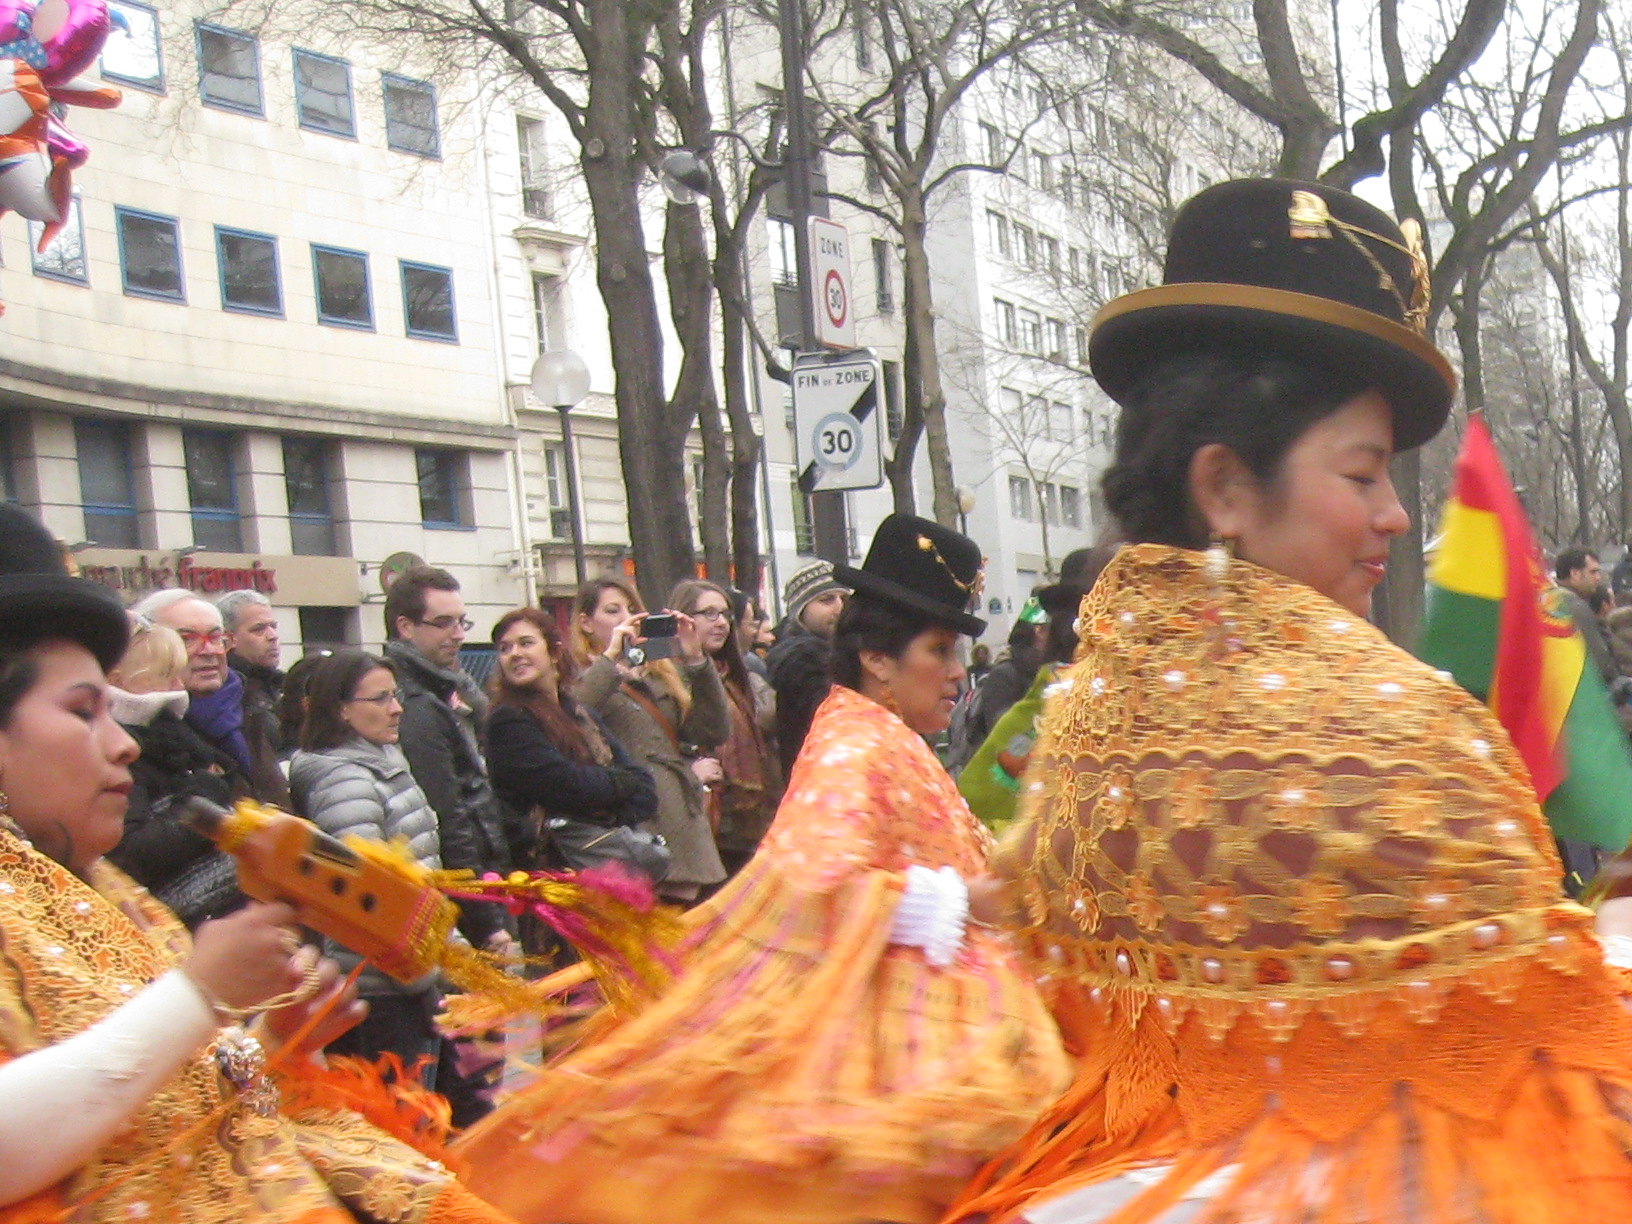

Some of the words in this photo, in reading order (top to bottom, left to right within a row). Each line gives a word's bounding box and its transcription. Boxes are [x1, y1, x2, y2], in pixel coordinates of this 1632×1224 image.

[820, 237, 844, 258] ZONE
[830, 288, 841, 309] 30
[798, 375, 819, 388] FIN
[835, 369, 871, 385] ZONE
[822, 430, 852, 454] 30
[179, 556, 278, 592] franprix
